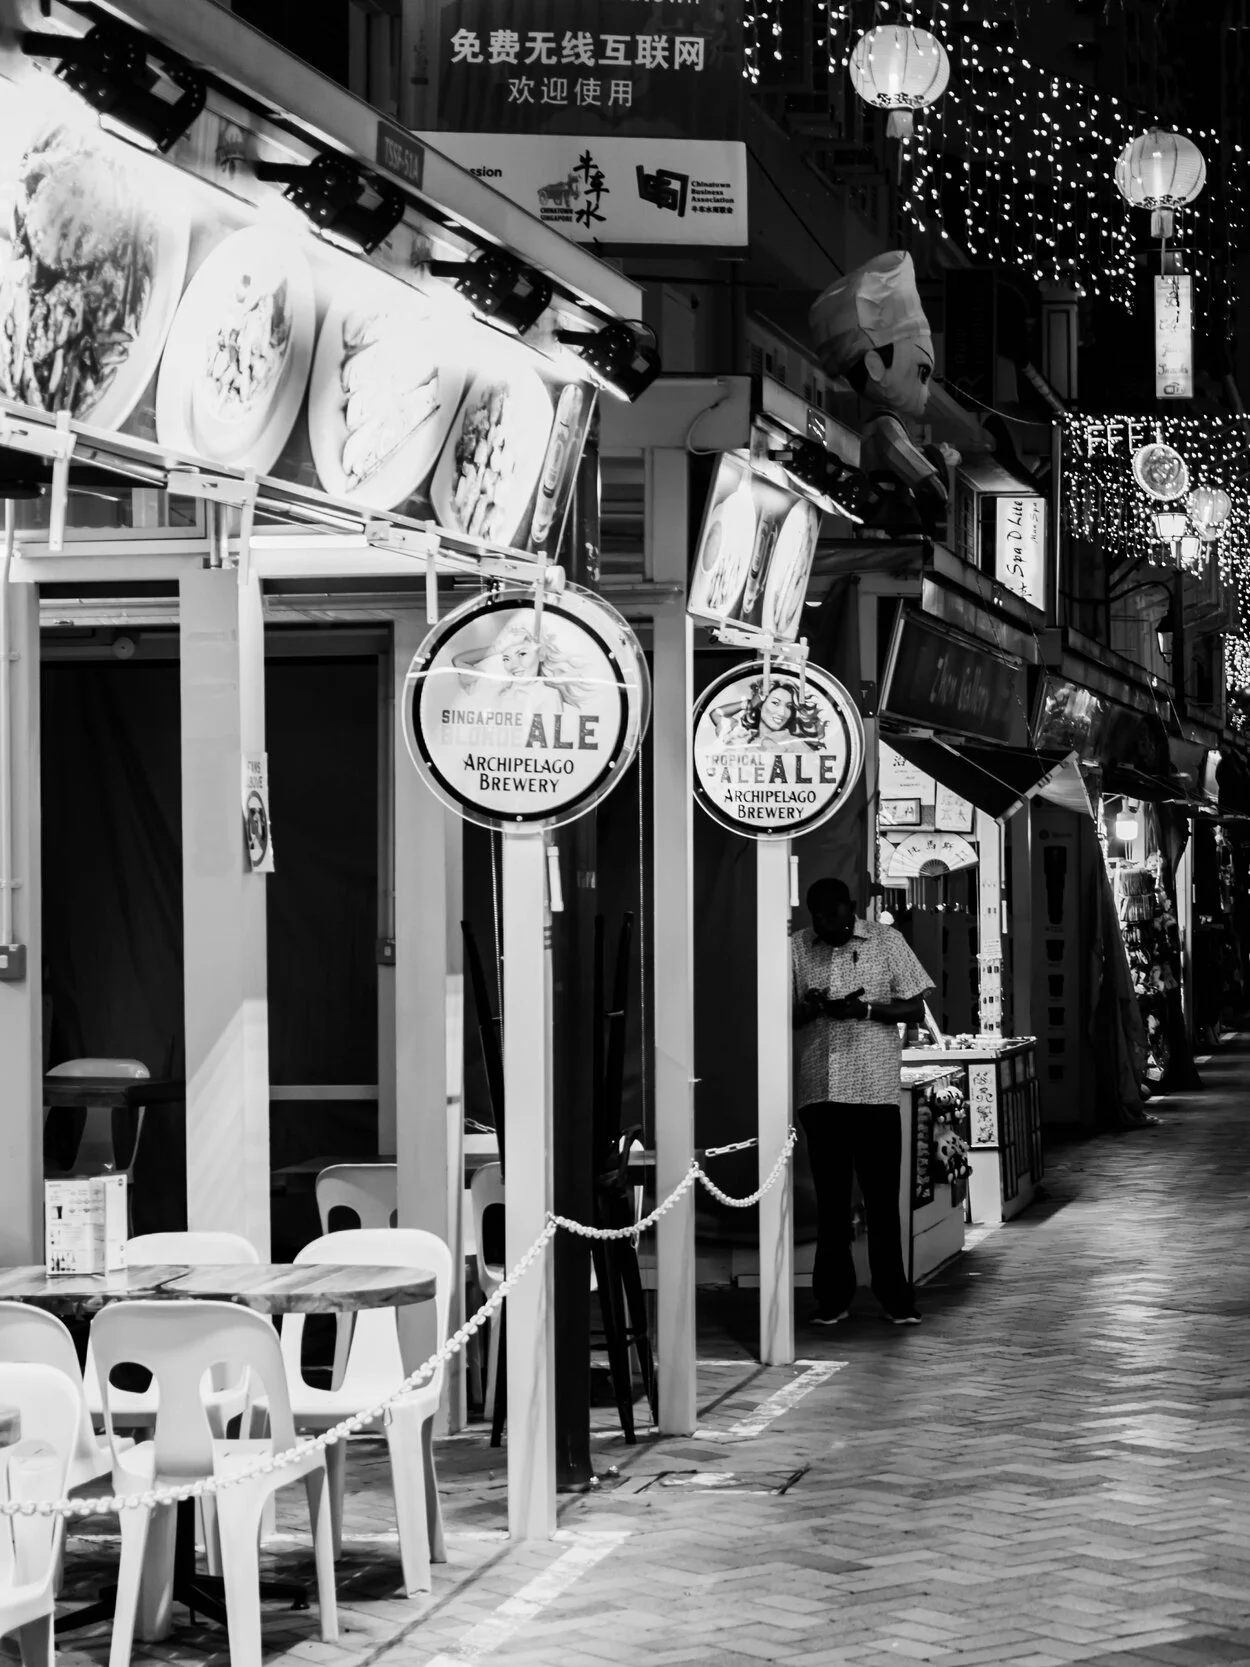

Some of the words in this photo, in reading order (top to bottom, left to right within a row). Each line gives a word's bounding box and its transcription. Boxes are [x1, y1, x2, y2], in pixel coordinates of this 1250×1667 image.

[450, 27, 706, 72] 免费无线互联网
[507, 76, 634, 107] 欢迎使用
[1006, 500, 1024, 527] Lite
[1006, 530, 1023, 541] D
[1006, 547, 1027, 578] Spa
[441, 709, 524, 727] SINGAPORE
[524, 713, 600, 751] ALE
[463, 753, 575, 774] ARCHIPELAGO
[768, 754, 837, 784] ALE
[479, 773, 560, 793] BREWERY
[724, 788, 817, 803] ARCHIPELAGO
[737, 804, 804, 820] BREWERY
